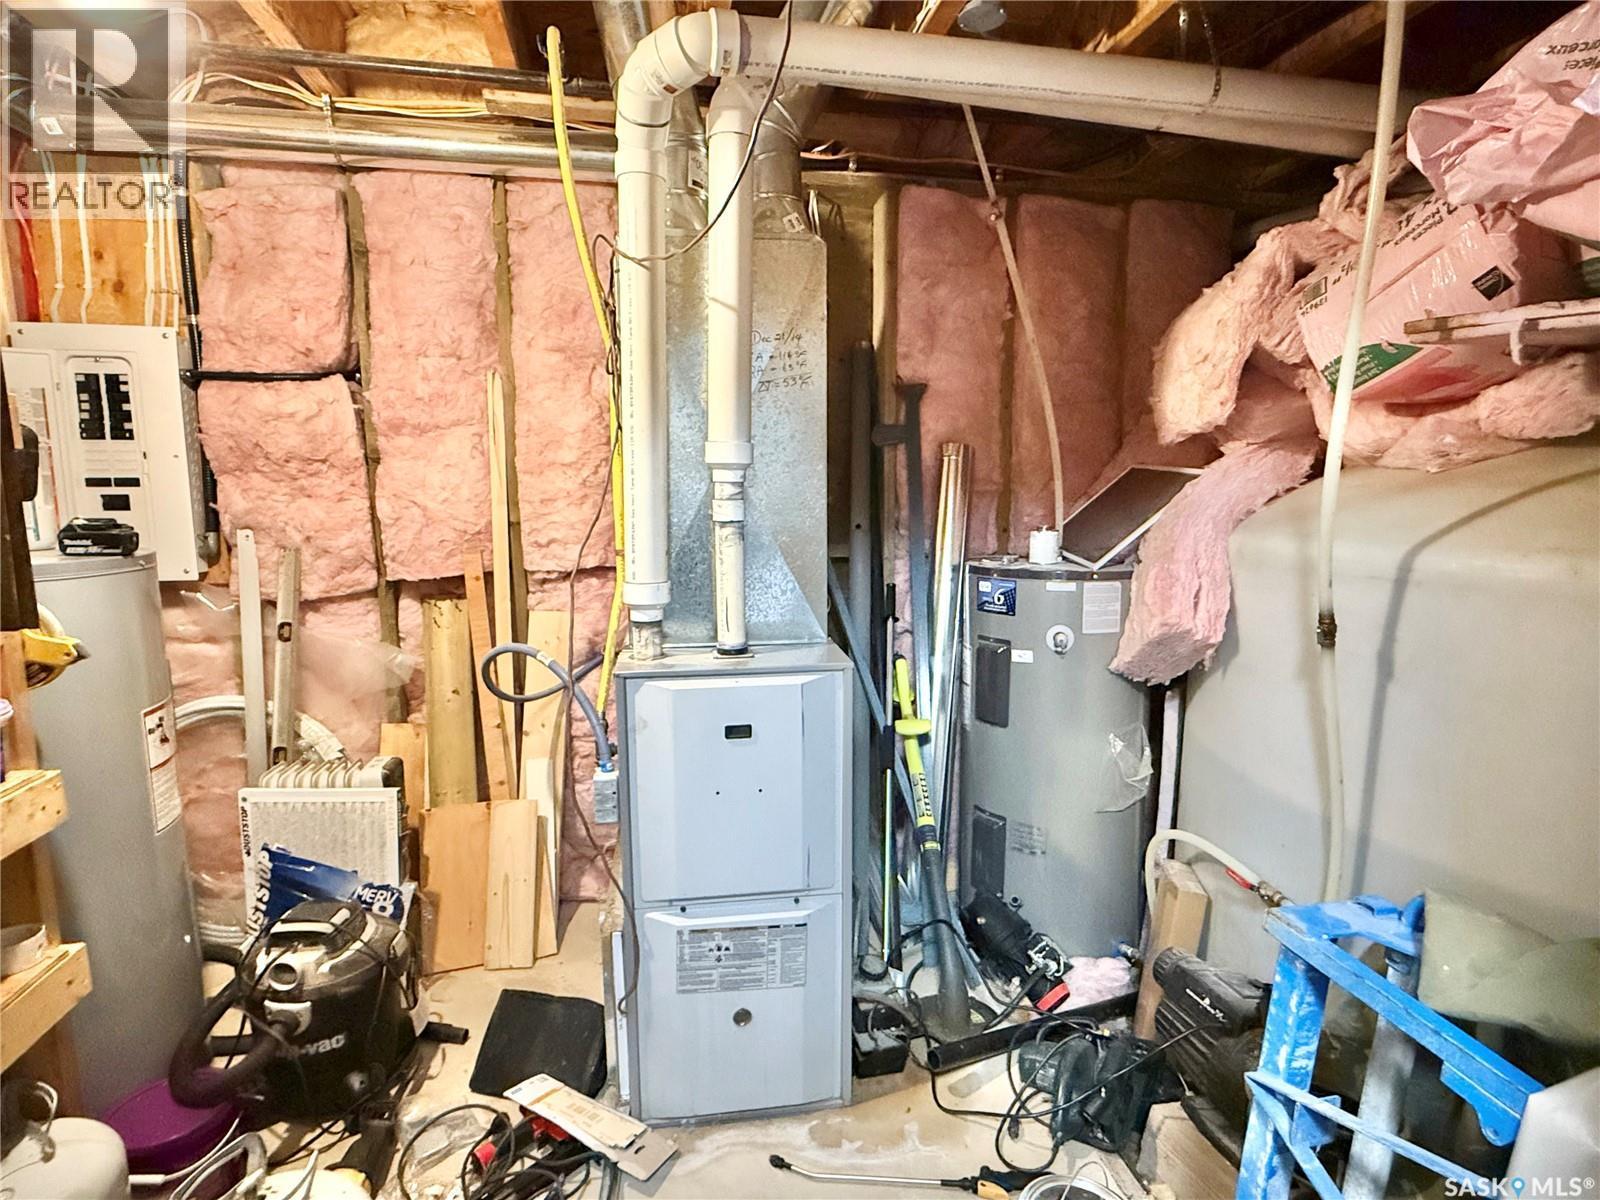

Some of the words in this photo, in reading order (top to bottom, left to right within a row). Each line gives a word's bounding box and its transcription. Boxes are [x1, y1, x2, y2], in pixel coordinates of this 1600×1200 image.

[752, 330, 773, 344] Dec
[994, 588, 1007, 605] 6
[241, 806, 251, 850] DUSTSTOP
[246, 850, 273, 937] USTSTOP
[353, 886, 399, 904] MERV
